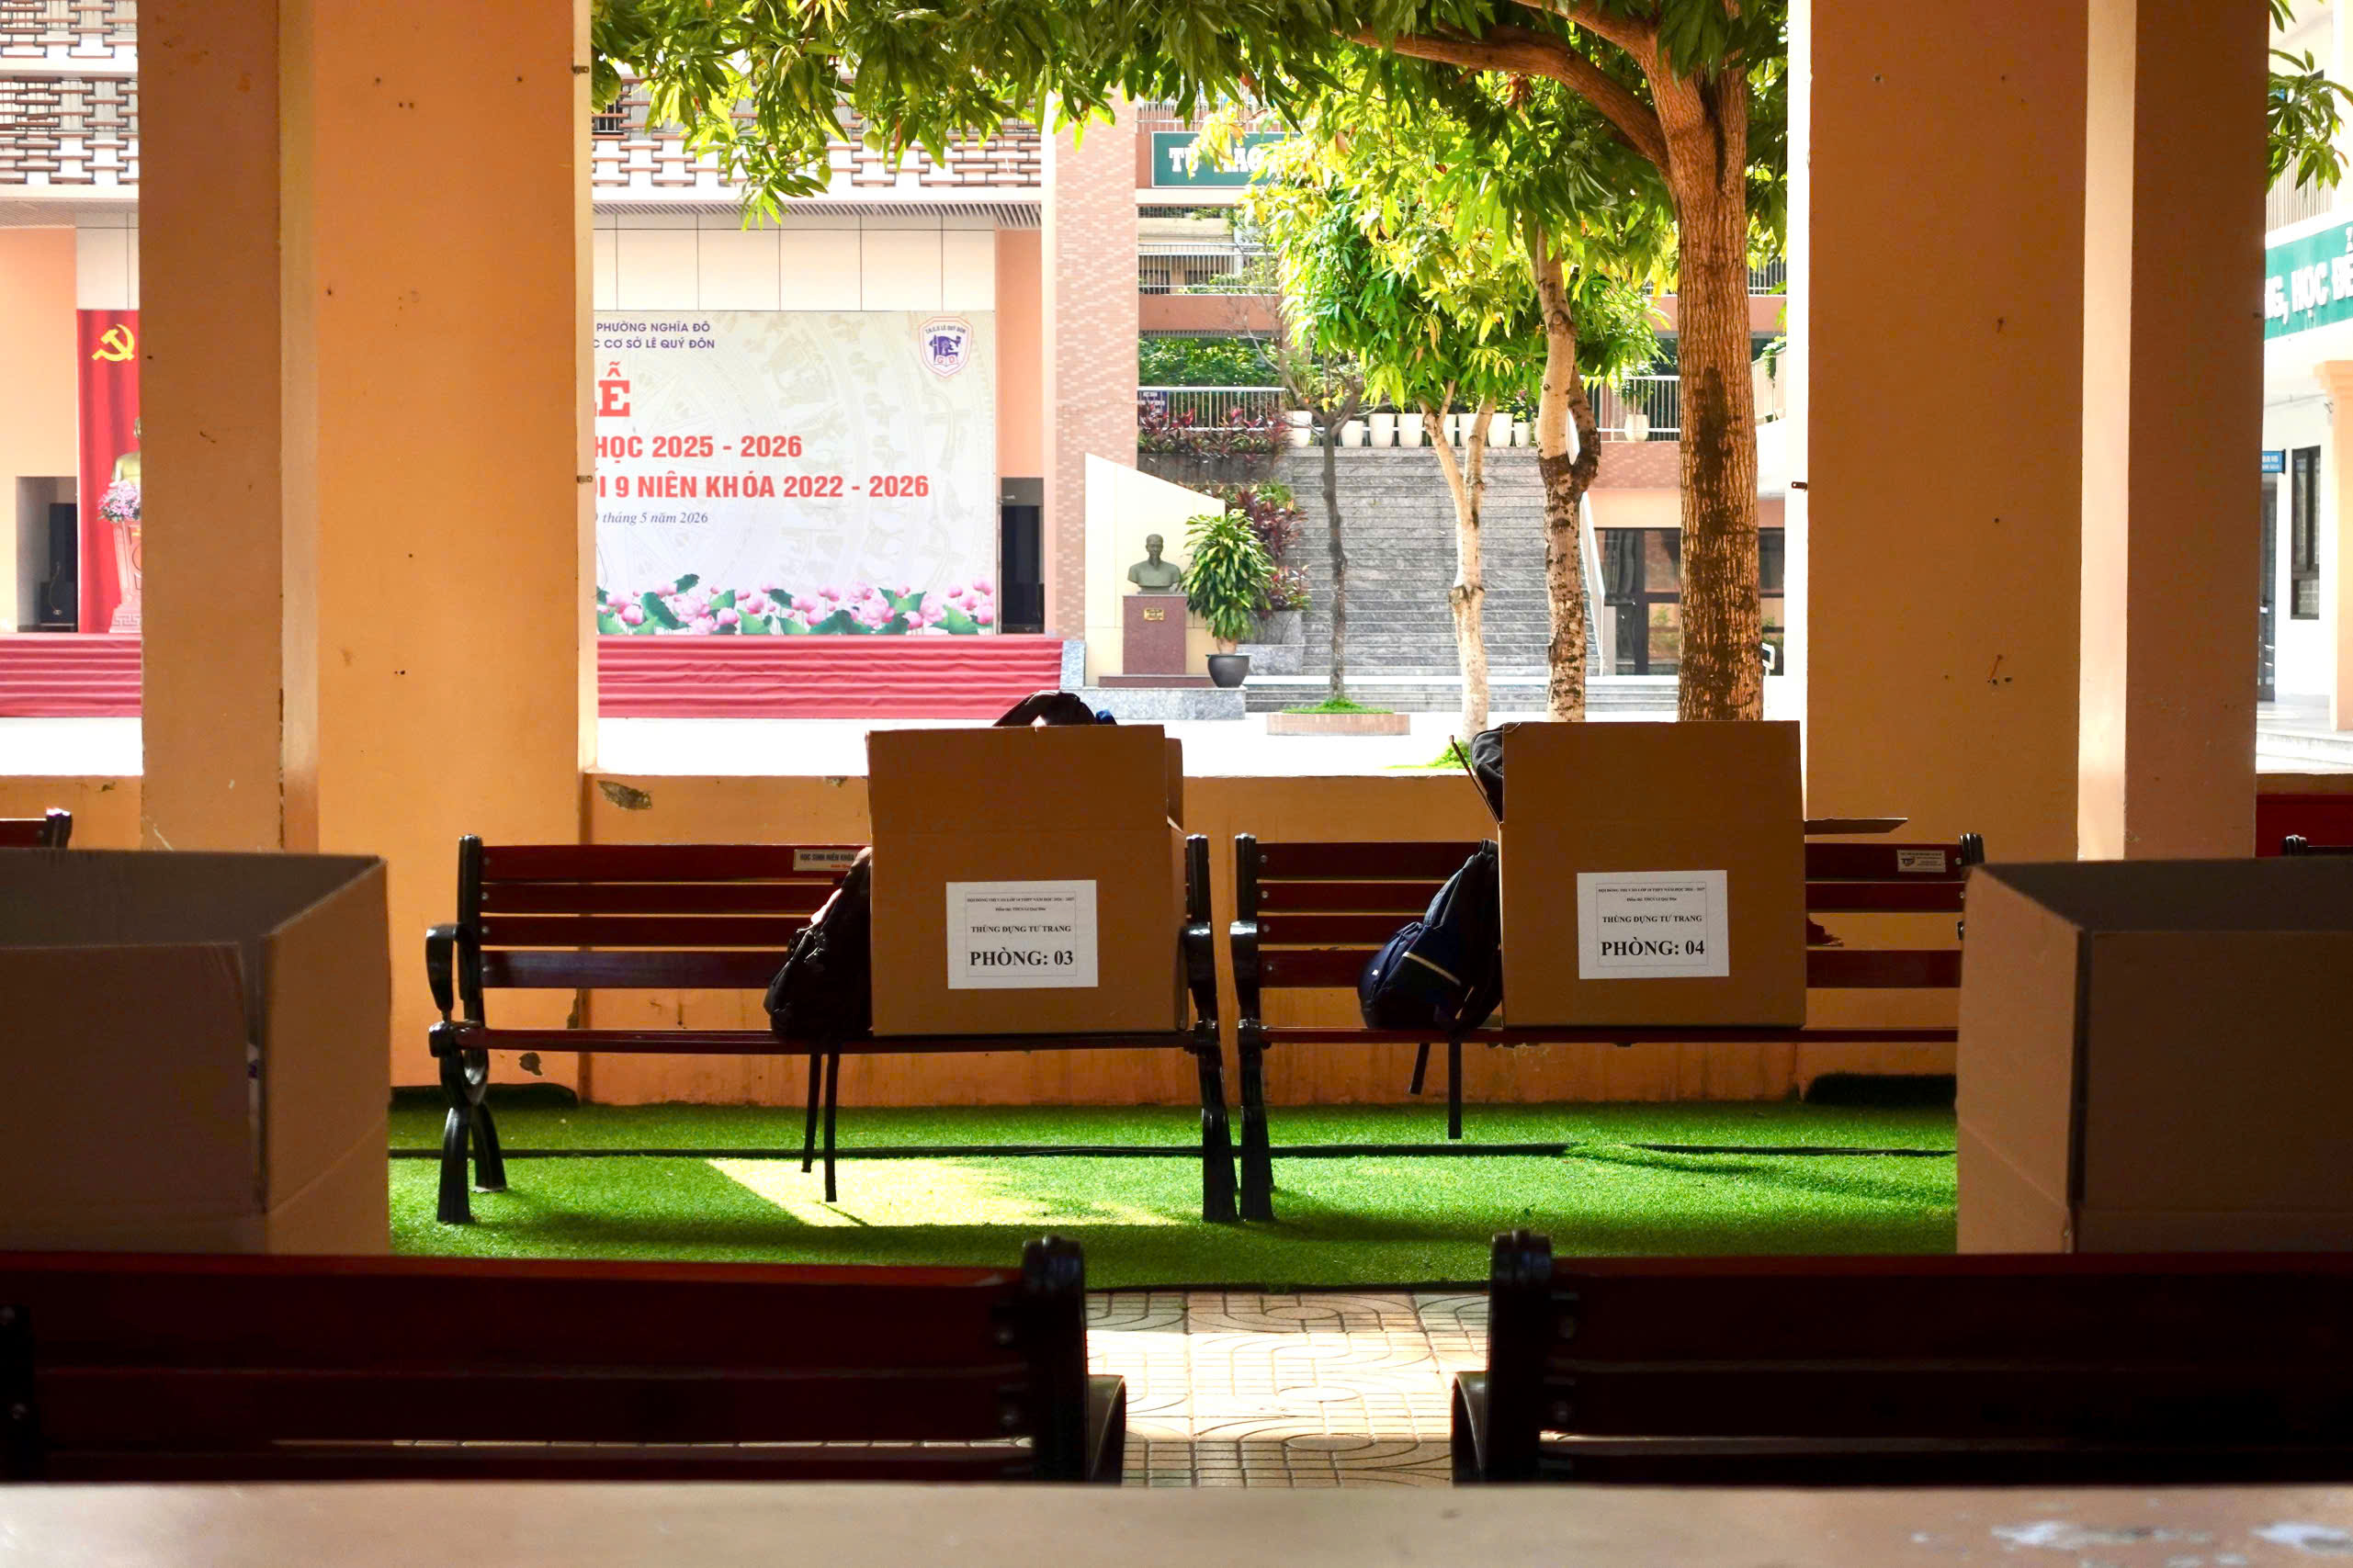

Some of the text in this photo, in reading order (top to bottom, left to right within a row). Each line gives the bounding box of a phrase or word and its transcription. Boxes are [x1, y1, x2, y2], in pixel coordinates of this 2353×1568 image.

[2291, 262, 2329, 318] HỌC
[596, 320, 710, 332] PHƯỜNG NGHĨA ĐÔ
[604, 338, 623, 348] CƠ
[626, 336, 642, 348] SỞ
[646, 336, 656, 348] LÊ
[660, 336, 684, 348] QUÝ
[689, 337, 715, 348] ĐÔN
[594, 361, 629, 416] Ễ
[594, 435, 643, 463] HỌC
[651, 435, 714, 457] 2025
[741, 435, 802, 457] 2026
[616, 476, 630, 498] 9
[638, 469, 697, 498] NIÊN
[706, 469, 775, 498] KHÓA
[783, 475, 843, 498] 2022
[868, 475, 929, 498] 2026
[603, 511, 637, 525] tháng
[639, 513, 648, 523] 5
[650, 513, 676, 523] năm
[680, 513, 708, 524] 2026
[1602, 915, 1632, 923] THÙNG
[1634, 915, 1657, 924] ĐỰNG
[1659, 914, 1672, 922] TƯ
[970, 924, 1001, 933] THÙNG
[1001, 925, 1026, 934] ĐỰNG
[1028, 924, 1042, 932] TƯ
[1601, 936, 1705, 956] PHÒNG: 04
[970, 947, 1073, 965] PHÒNG: 03
